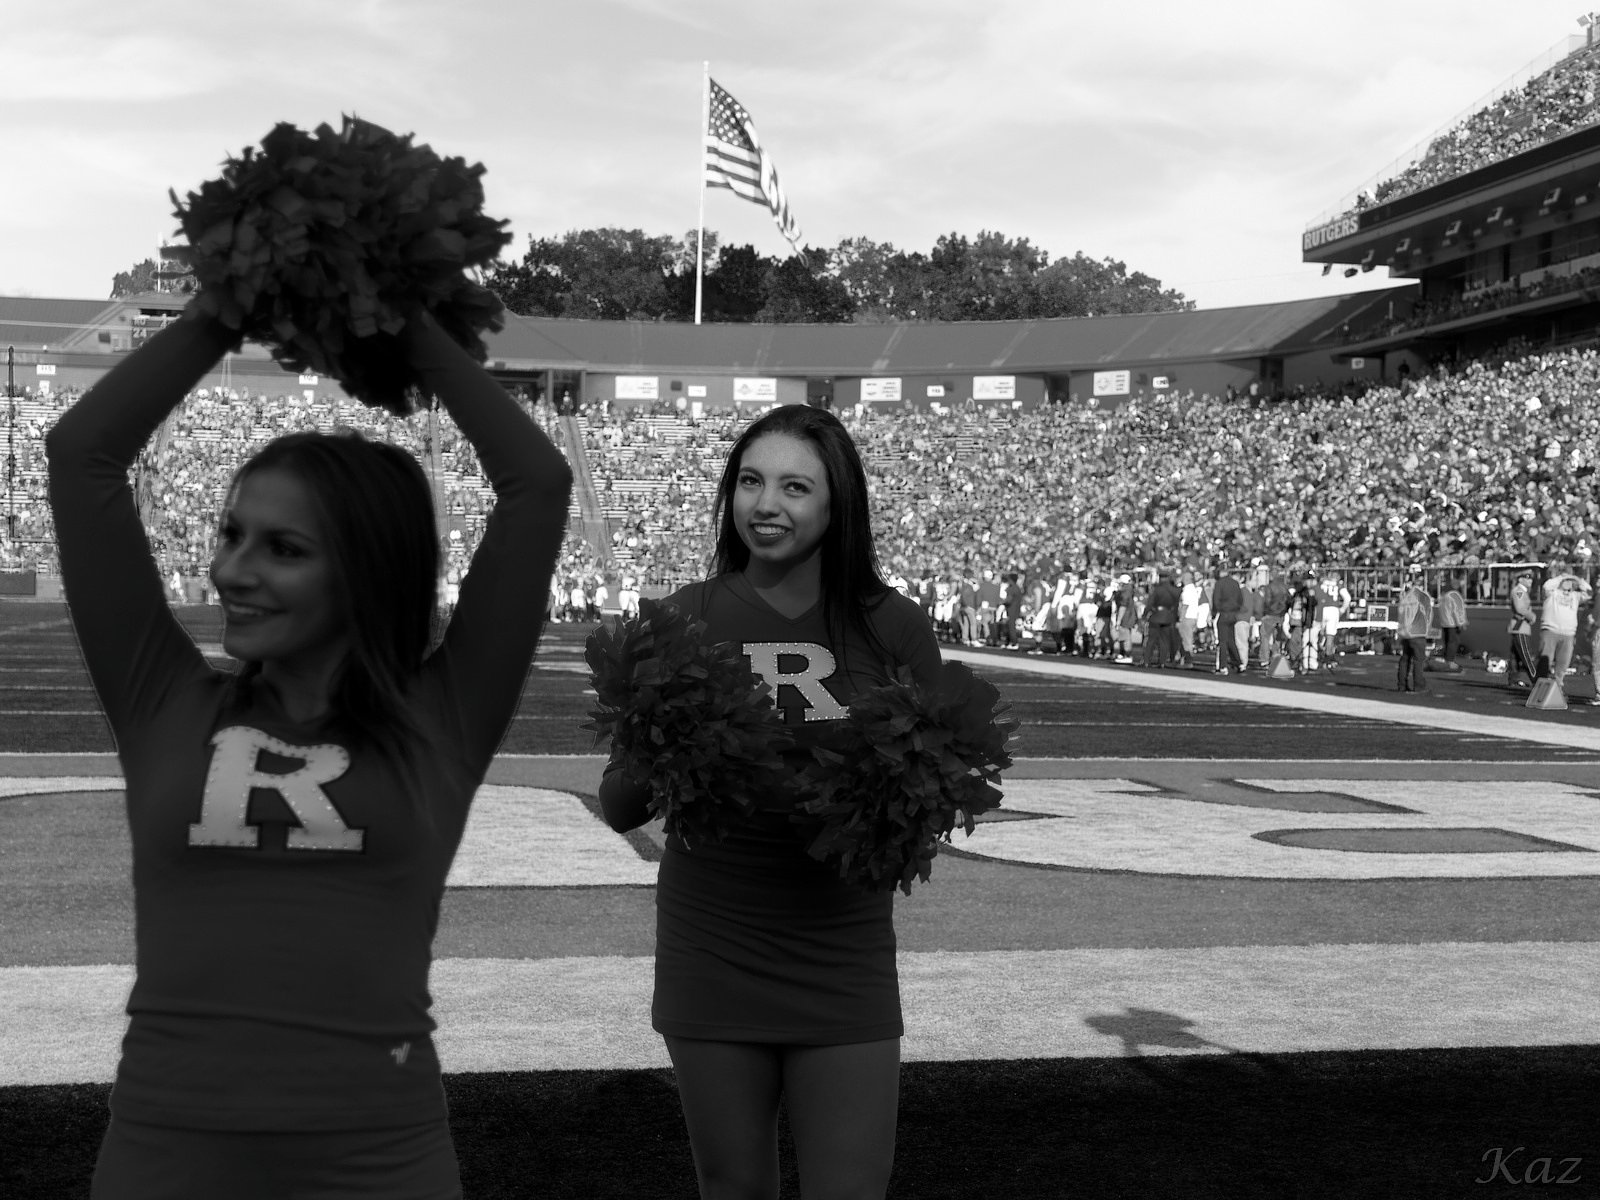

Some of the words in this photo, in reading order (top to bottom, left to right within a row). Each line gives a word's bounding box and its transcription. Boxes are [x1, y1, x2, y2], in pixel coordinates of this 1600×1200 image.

[1303, 215, 1359, 251] RUTGERS
[742, 641, 850, 721] R
[188, 725, 363, 851] R
